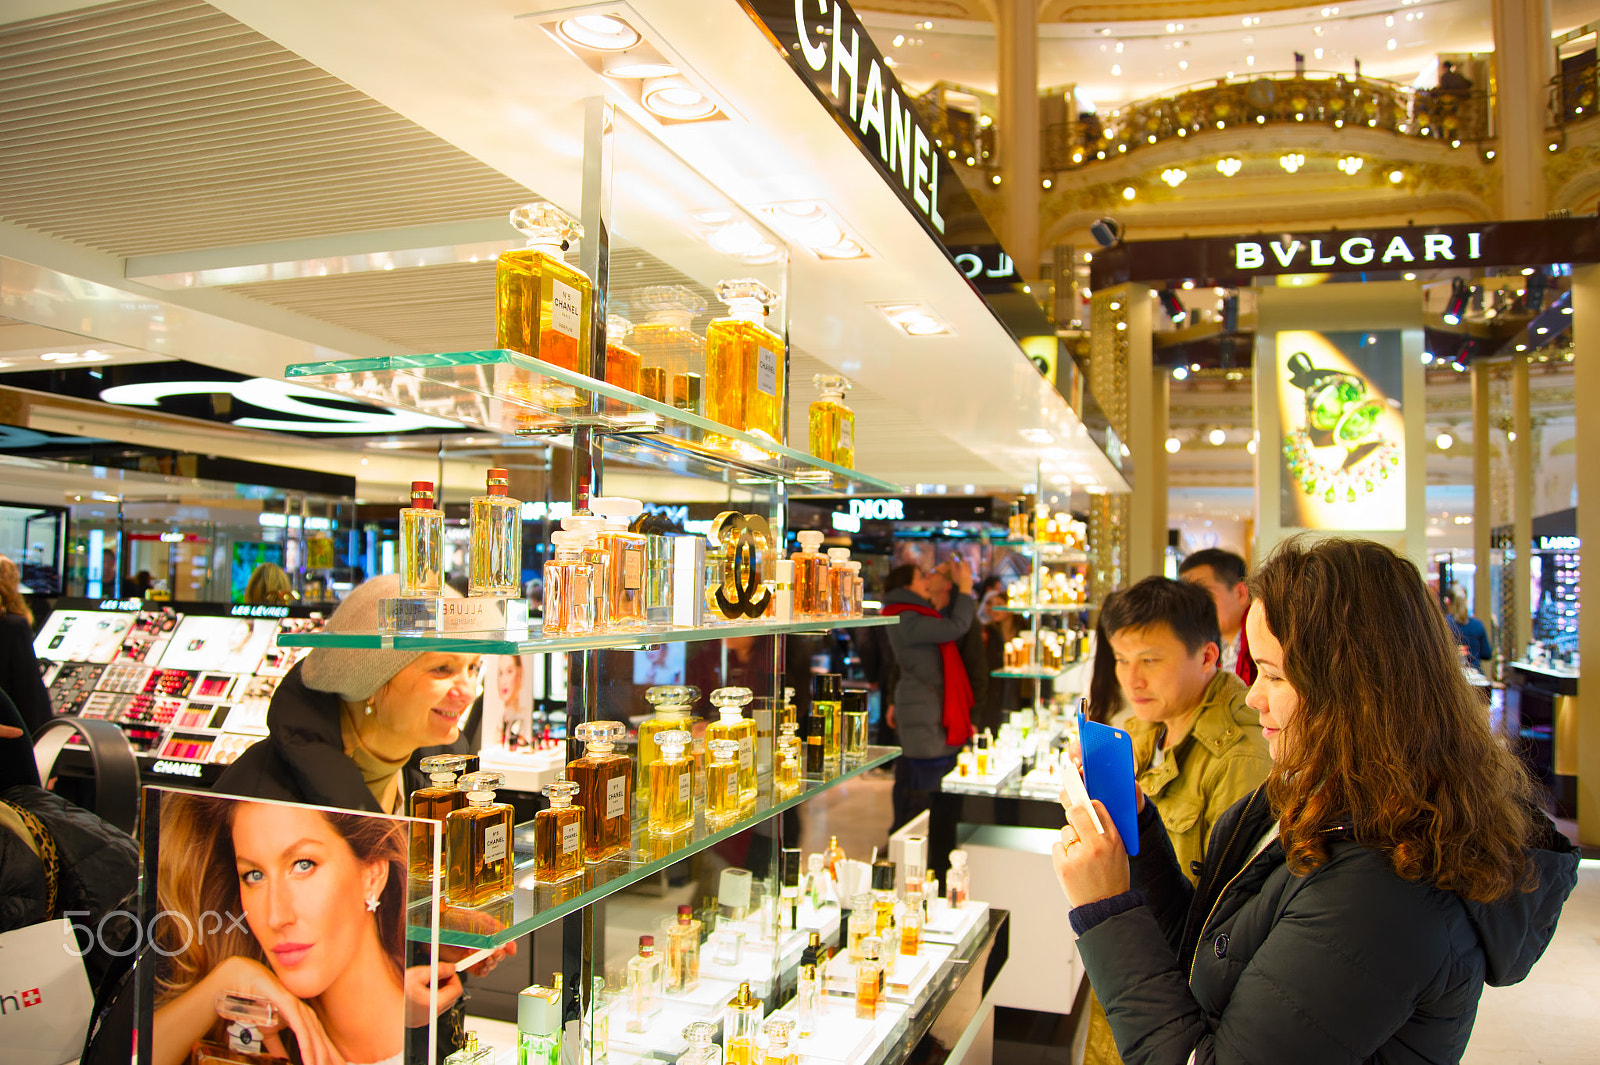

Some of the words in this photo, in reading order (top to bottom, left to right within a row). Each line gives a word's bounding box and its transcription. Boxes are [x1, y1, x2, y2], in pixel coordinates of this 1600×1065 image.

[794, 0, 945, 235] CHANEL
[1235, 232, 1481, 269] BVLGARI
[554, 297, 579, 316] CHANEL
[848, 498, 905, 520] DIOR
[99, 600, 118, 610] LES
[231, 604, 251, 616] LES
[152, 760, 202, 777] CHANEL
[608, 791, 624, 801] CHANEL
[486, 837, 505, 847] CHANEL
[563, 832, 578, 841] CHANEL
